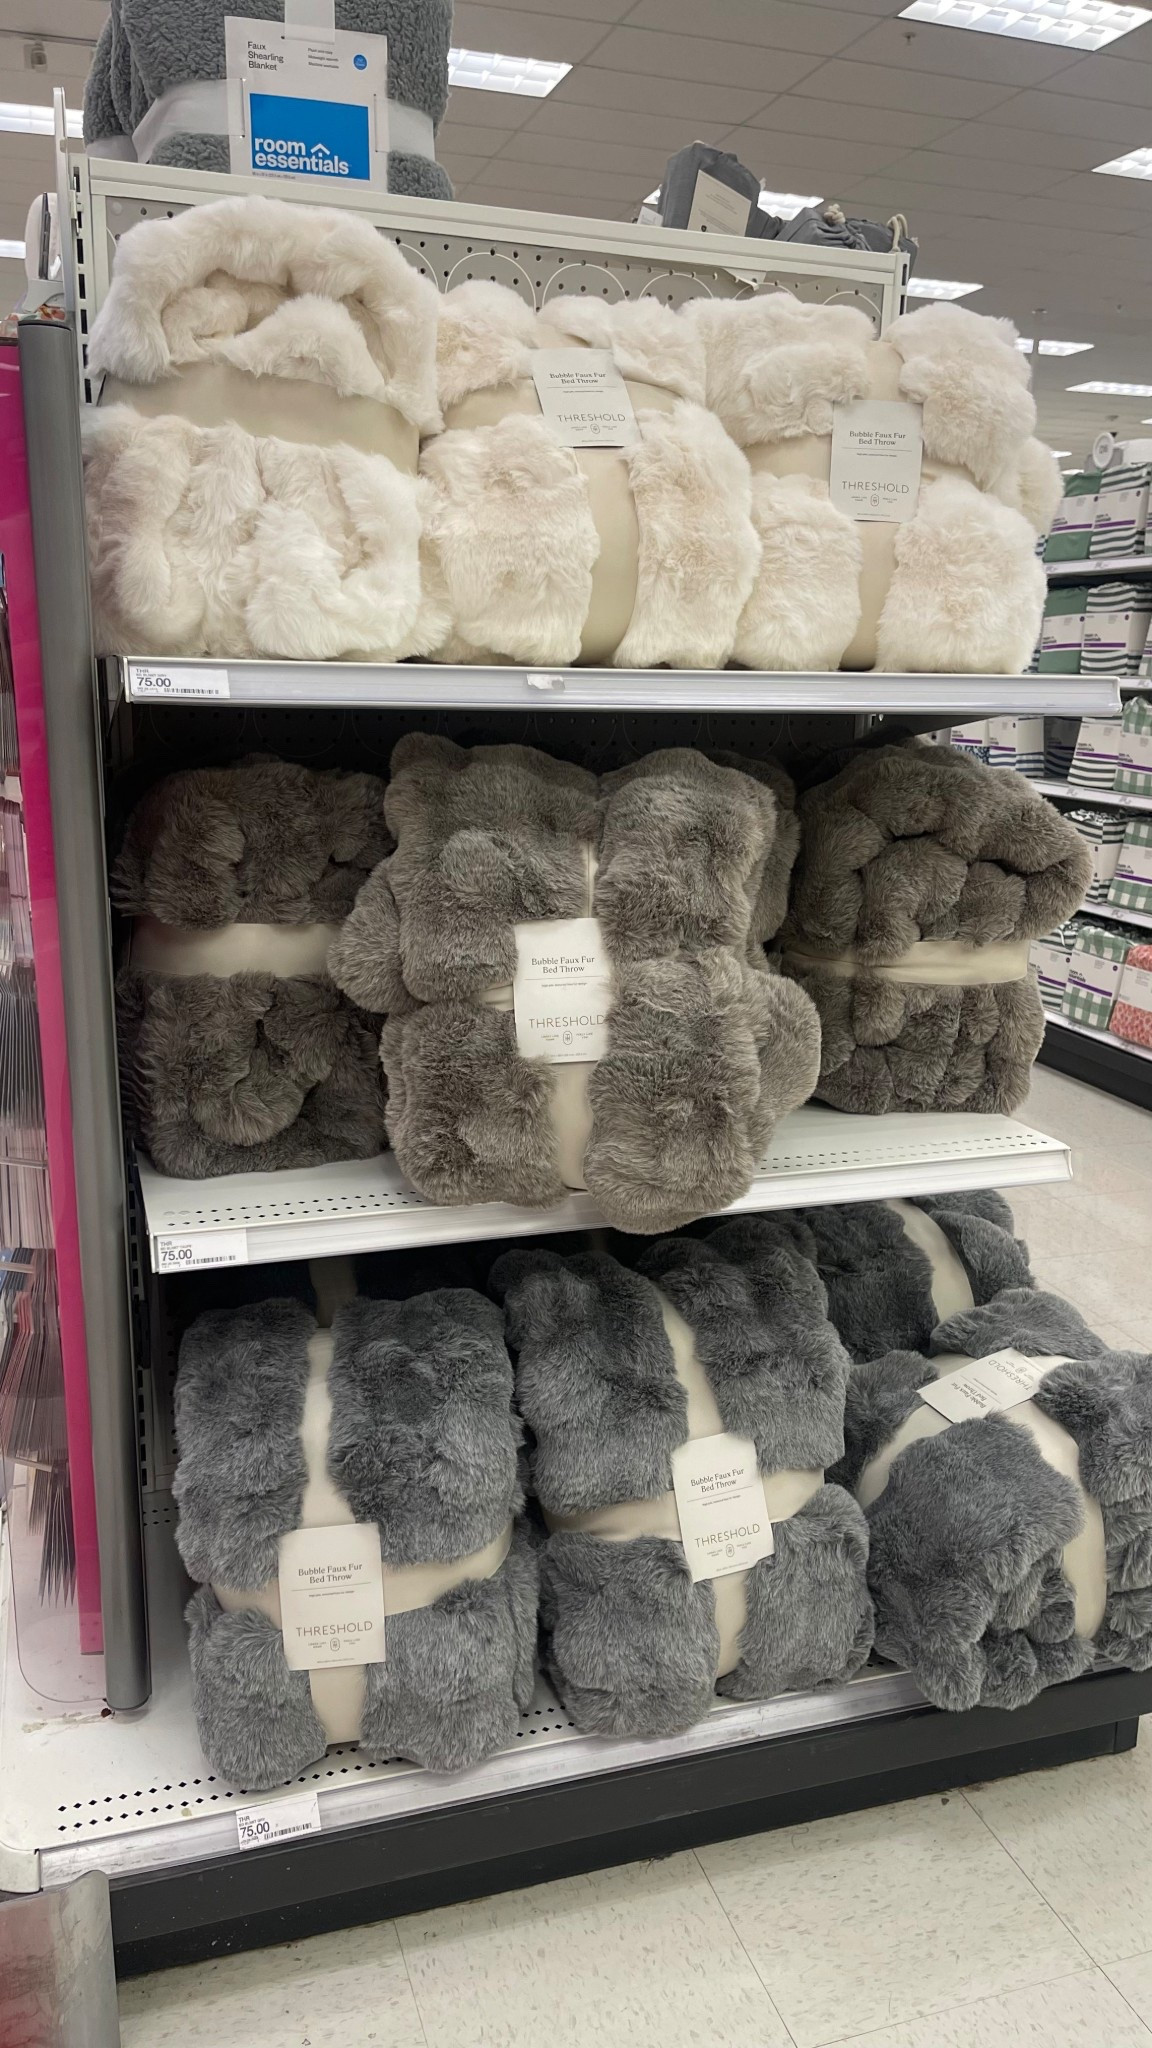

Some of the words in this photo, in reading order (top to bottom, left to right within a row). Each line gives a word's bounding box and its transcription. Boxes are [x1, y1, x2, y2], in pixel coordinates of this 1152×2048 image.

[247, 41, 266, 50] Faux
[248, 51, 284, 63] Shearling
[248, 61, 277, 71] Blanket
[254, 137, 306, 156] room
[255, 152, 349, 175] essentials
[557, 413, 626, 422] THRESHOLD
[842, 481, 909, 494] THRESHOLD
[137, 677, 171, 687] 75.00
[531, 957, 558, 966] Bubble
[560, 956, 580, 965] Faux
[581, 955, 595, 964] Fur
[543, 966, 558, 974] Bed
[560, 965, 585, 973] Throw
[529, 1014, 605, 1029] THRESHOLD
[161, 1249, 192, 1261] 75.00
[988, 1359, 1033, 1391] THRESHOLD
[690, 1475, 713, 1487] Bubble
[714, 1471, 731, 1482] Faux
[732, 1468, 744, 1477] Fur
[701, 1484, 714, 1493] Bed
[716, 1479, 737, 1489] Throw
[694, 1523, 760, 1548] THRESHOLD
[298, 1566, 325, 1576] Bubble
[327, 1565, 347, 1573] Faux
[348, 1563, 363, 1571] Fur
[309, 1576, 325, 1584] Bed
[327, 1573, 353, 1582] Throw
[296, 1620, 373, 1637] THRESHOLD
[240, 1822, 270, 1838] 75.00
